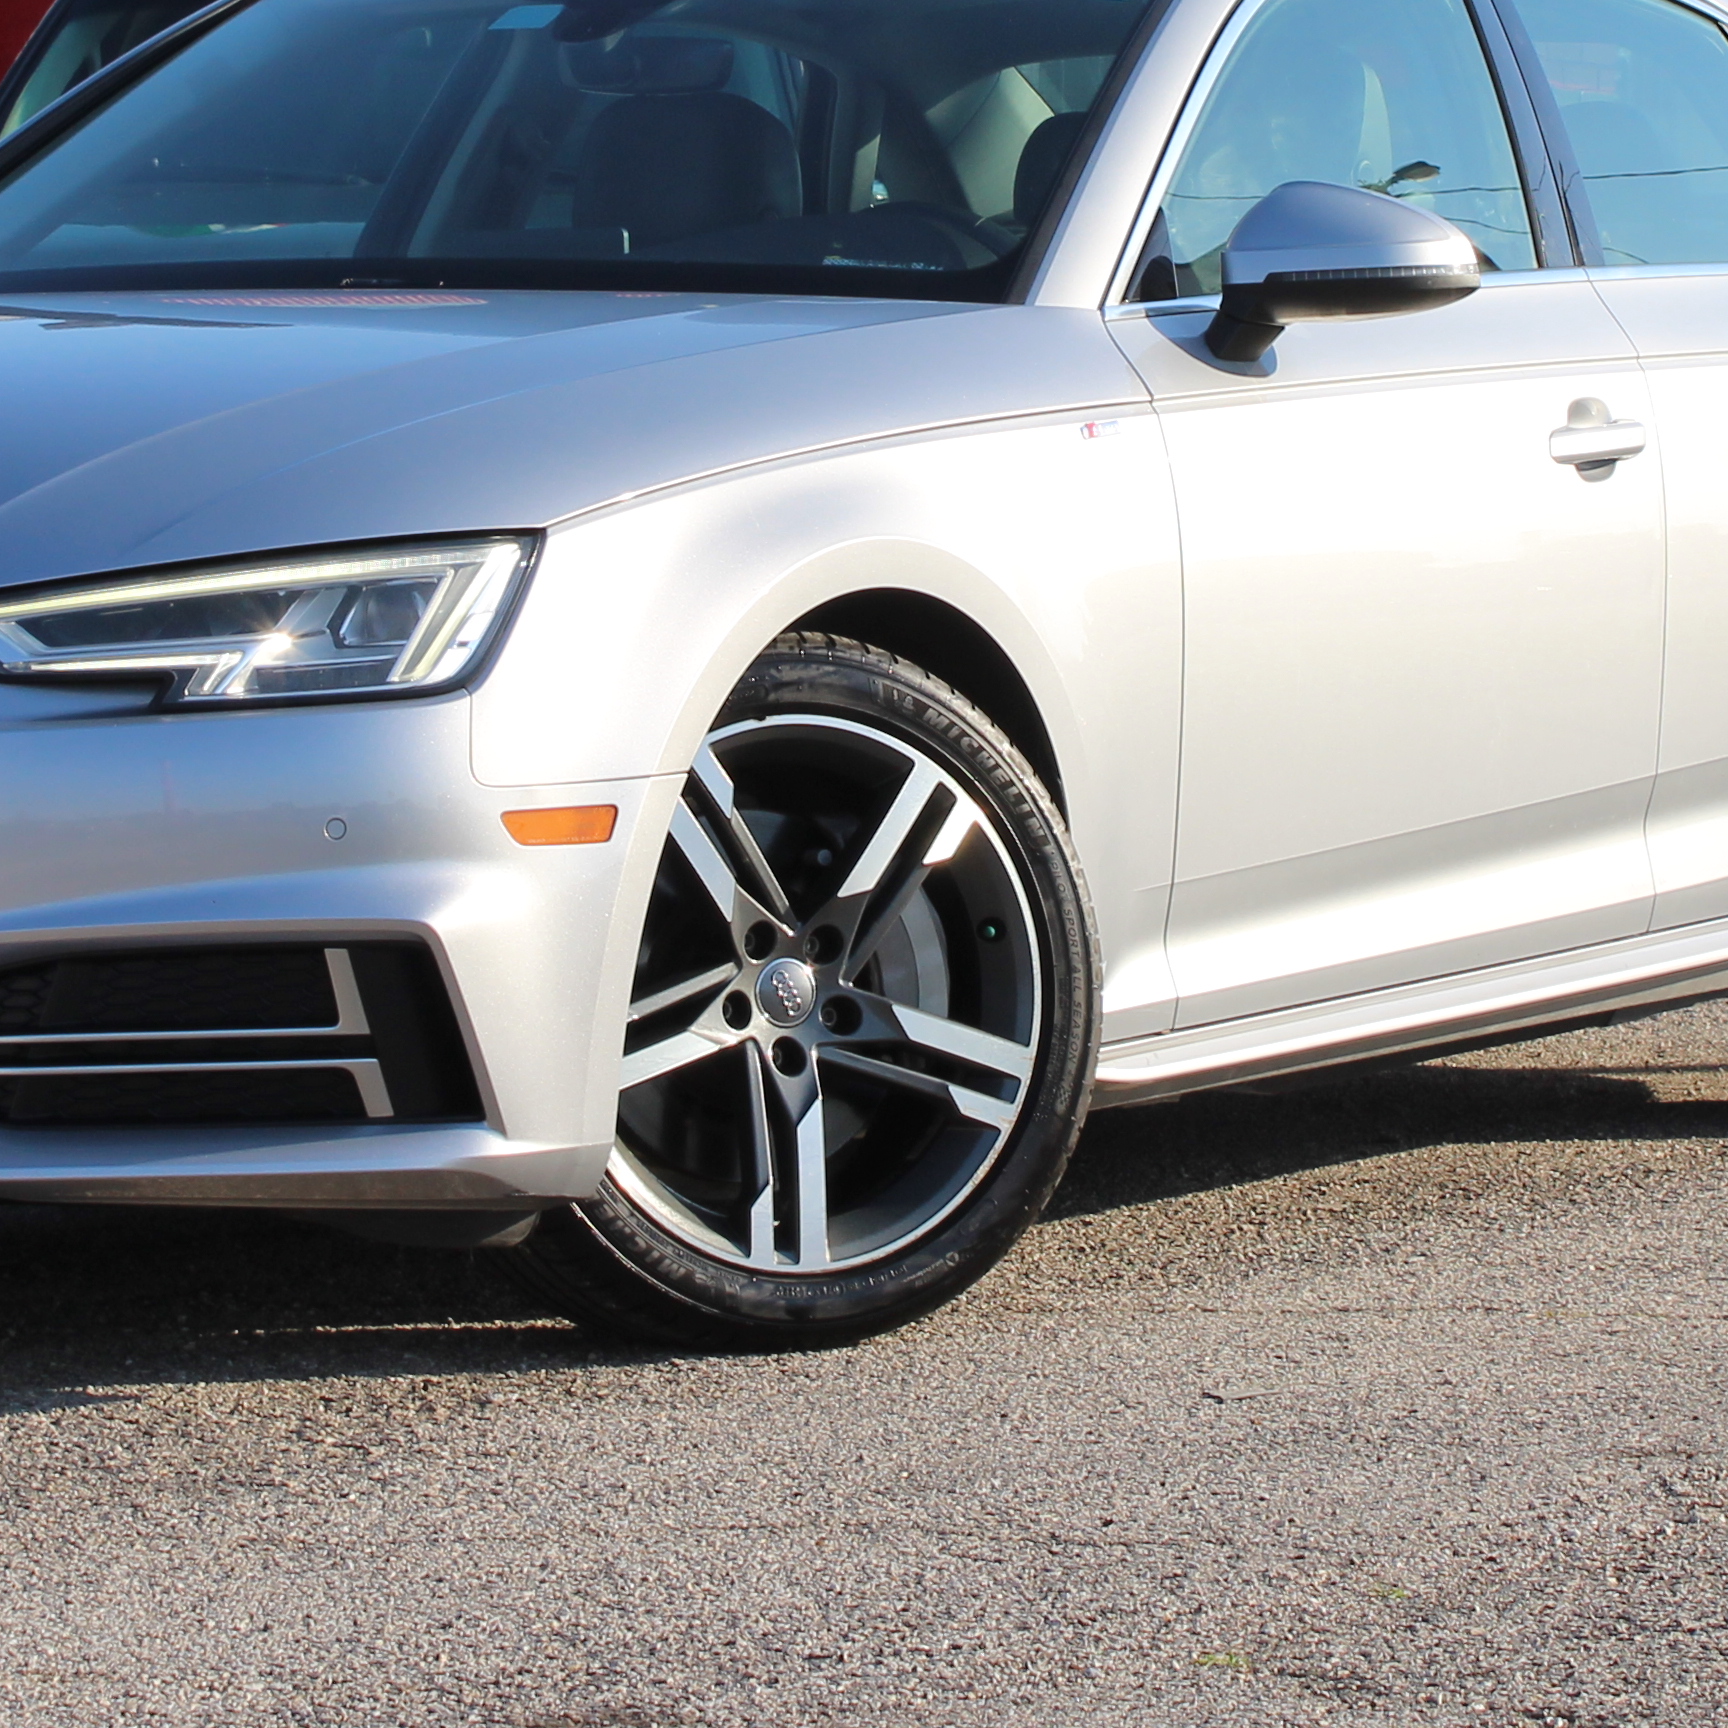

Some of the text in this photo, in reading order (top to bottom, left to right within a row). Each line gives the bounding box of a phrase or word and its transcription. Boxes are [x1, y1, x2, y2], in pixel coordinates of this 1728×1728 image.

[924, 707, 1051, 846] MICHELIN
[1063, 909, 1080, 957] SPORT
[1073, 965, 1083, 992] ALL
[1069, 1001, 1083, 1064] SEASON
